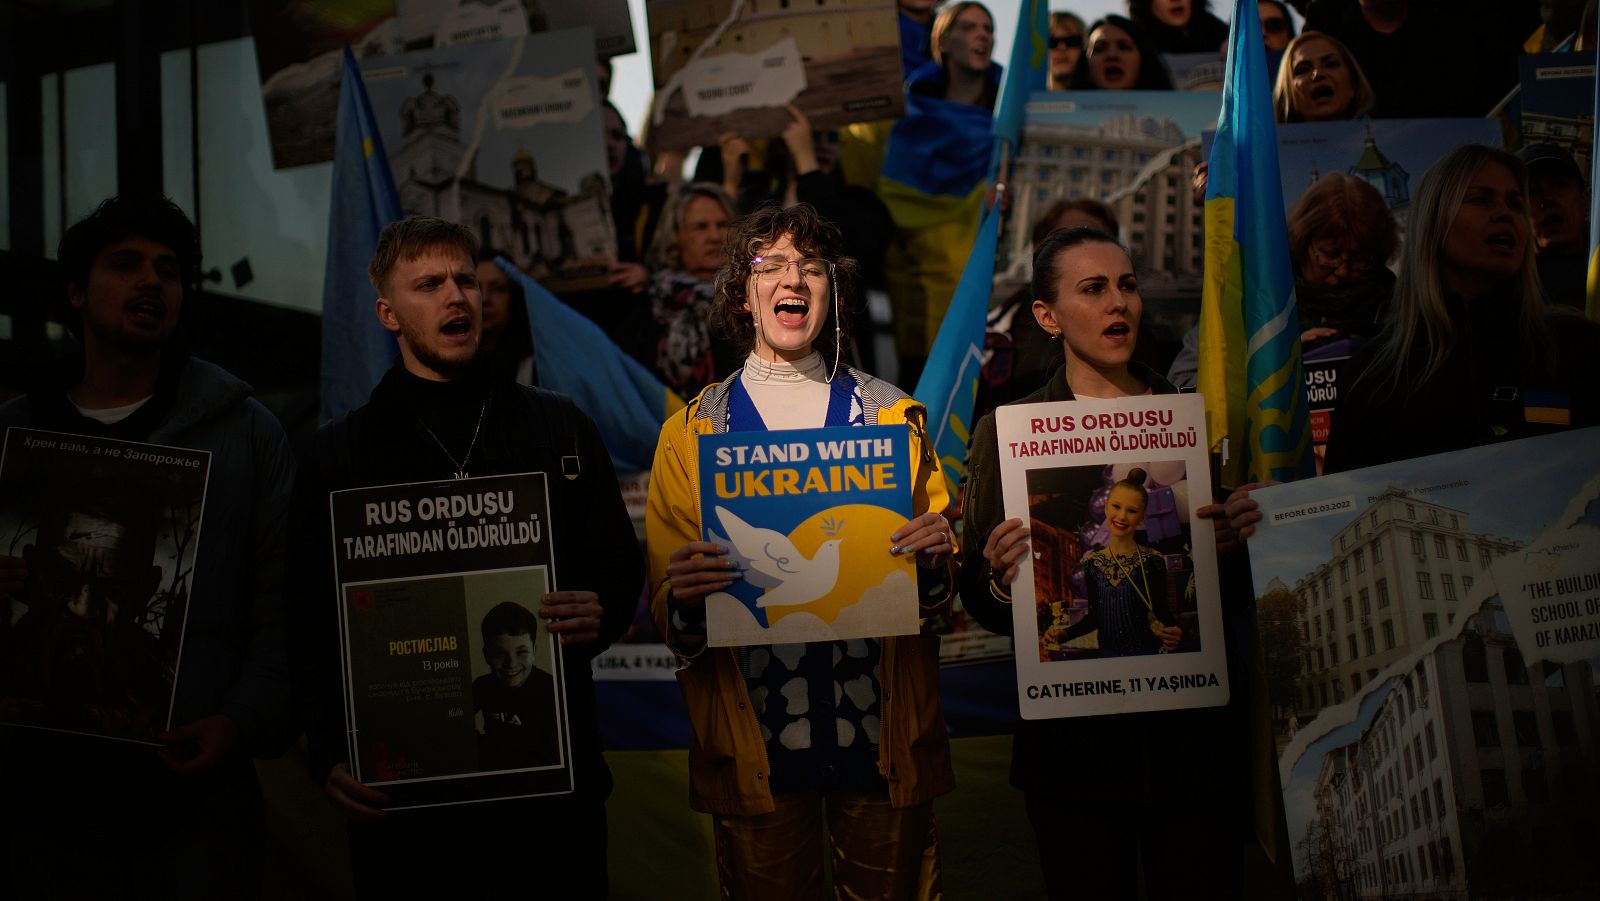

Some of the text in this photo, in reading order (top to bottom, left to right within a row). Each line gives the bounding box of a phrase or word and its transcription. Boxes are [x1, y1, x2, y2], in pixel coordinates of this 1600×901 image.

[1031, 409, 1173, 434] RUS ORDUSU
[23, 434, 201, 469] Хрен вам, а не Запорожье
[715, 437, 892, 466] STAND WITH
[1009, 427, 1197, 459] TARAFINDAN ÖLDÜRÜLDÜ
[714, 462, 897, 499] UKRAINE
[365, 490, 514, 526] RUS ORDUSU
[1274, 500, 1351, 521] BEFORE 02.03.2022
[343, 513, 542, 560] TARAFINDAN ÖLDÜRÜLDÜ
[1531, 598, 1600, 624] SCHOOL OF
[389, 636, 458, 656] РОСТИСЛАВ
[1535, 622, 1600, 648] OF KARAZI
[423, 657, 460, 672] 13 років
[1026, 672, 1220, 700] CATHERINE, 11 YAŞINDA
